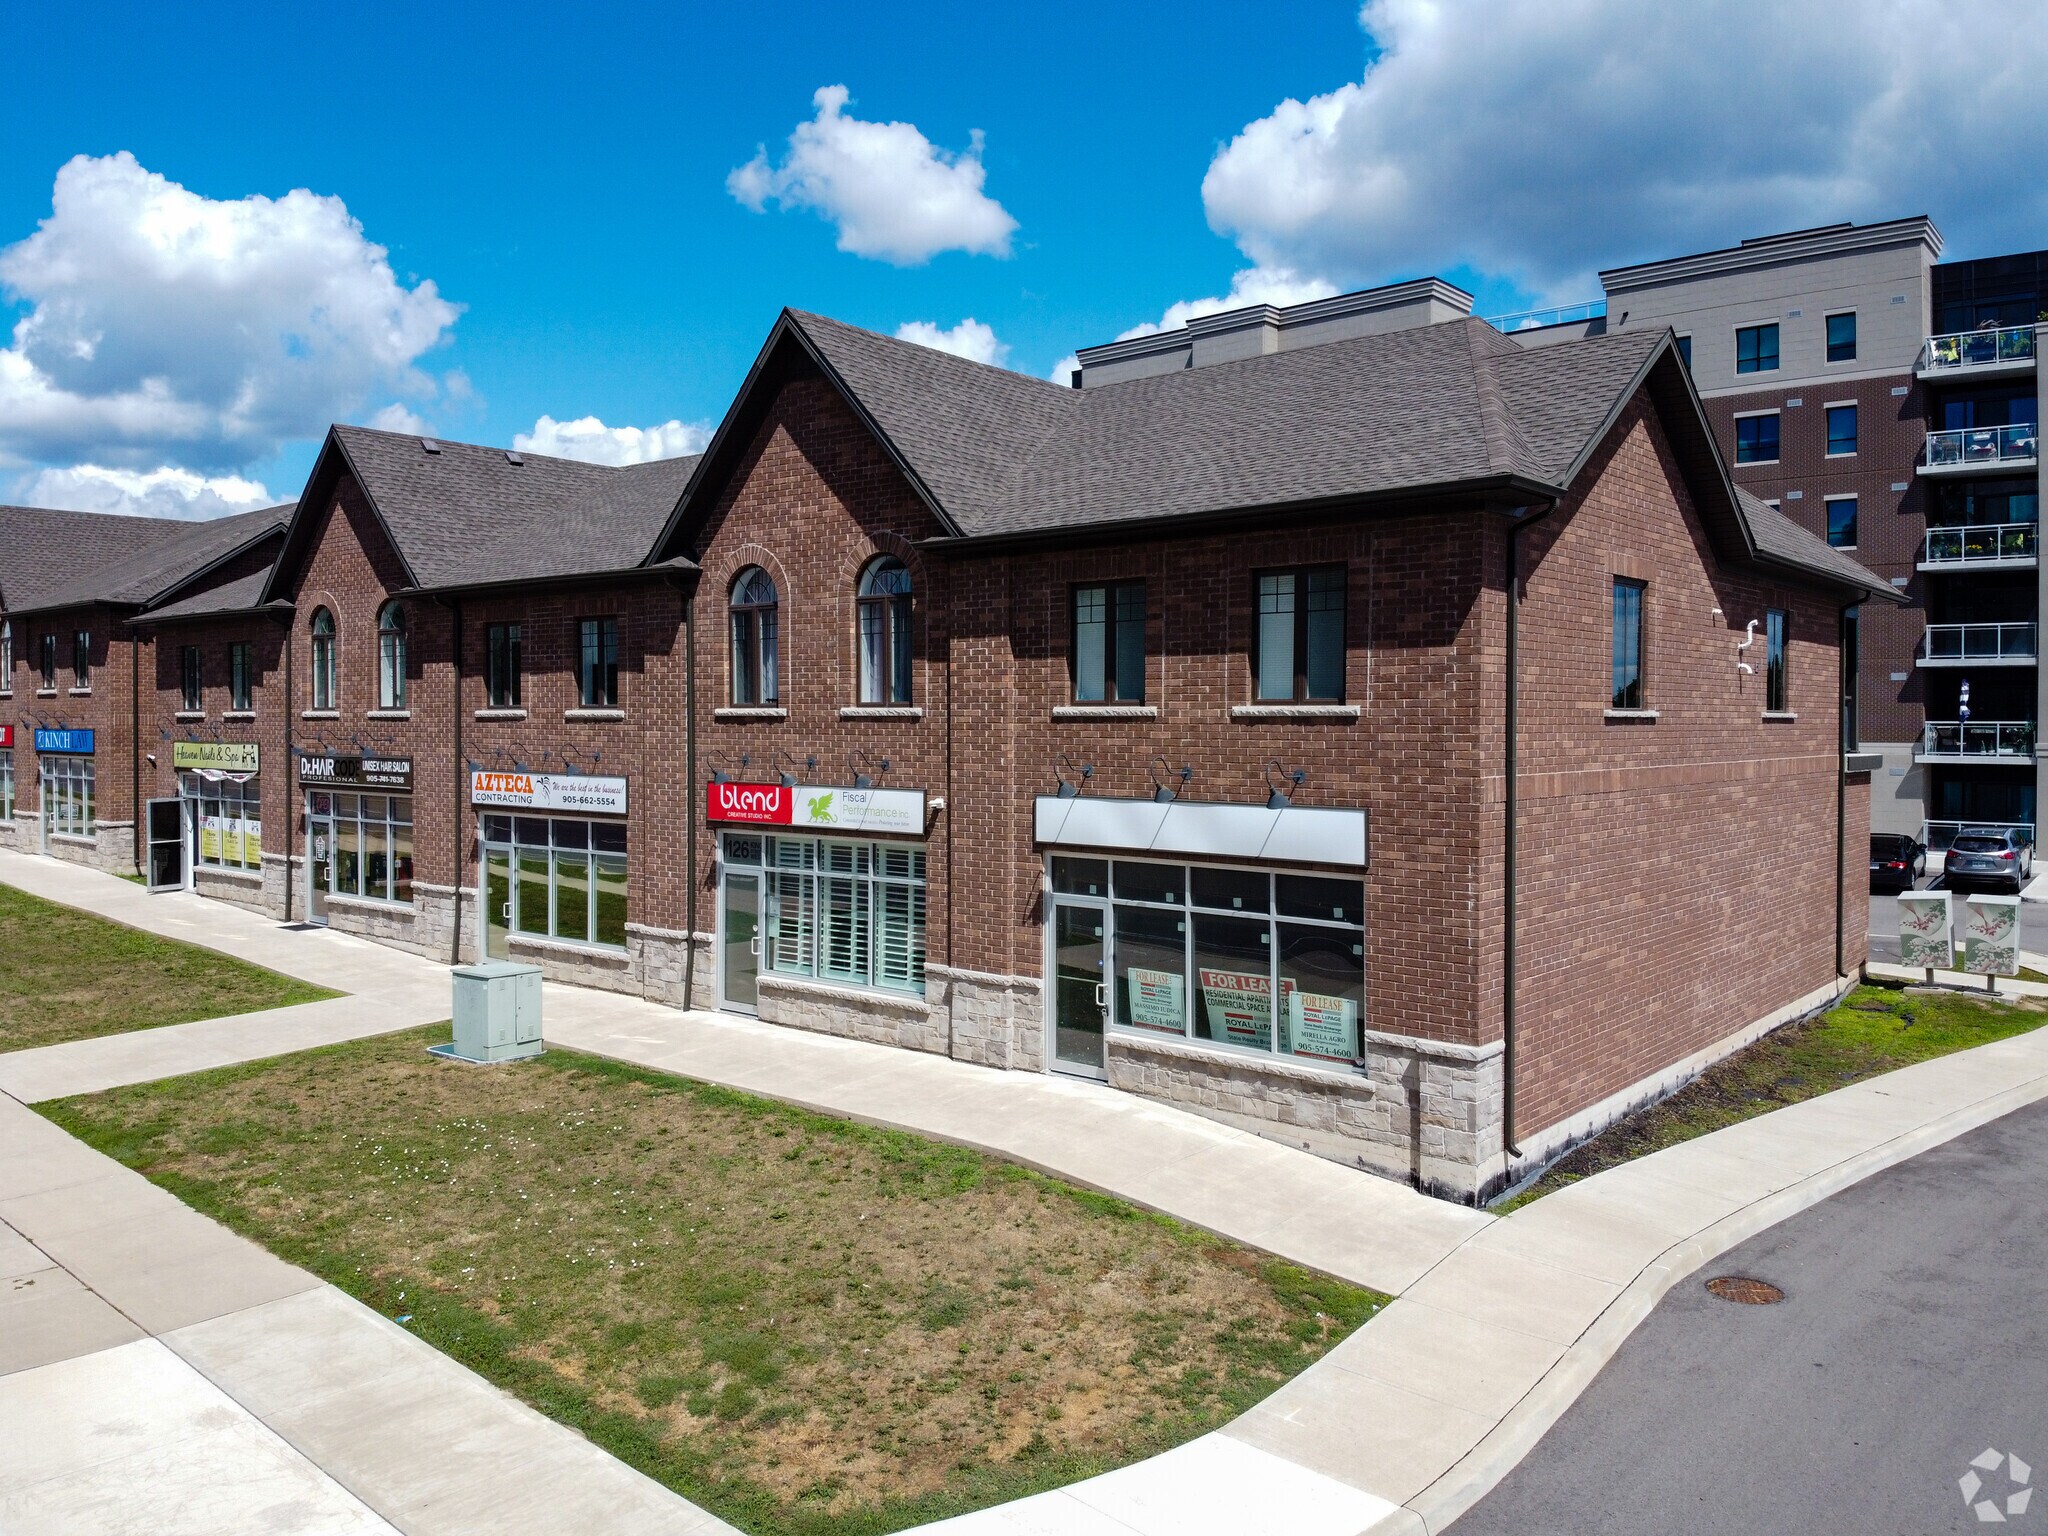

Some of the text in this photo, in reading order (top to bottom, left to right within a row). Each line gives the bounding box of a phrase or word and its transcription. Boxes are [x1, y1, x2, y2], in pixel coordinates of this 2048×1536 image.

[45, 732, 89, 749] KINCH LAW
[176, 746, 240, 767] Heaven Nails & Spa
[362, 760, 410, 773] UNISEX HAIR SALON
[302, 775, 358, 783] PROFESIONAL
[366, 775, 404, 784] 905-741-7638
[475, 773, 534, 794] AZTECA
[569, 783, 577, 791] the
[577, 783, 587, 793] best
[587, 785, 593, 793] in
[593, 783, 601, 793] the
[602, 784, 624, 795] business!
[475, 792, 533, 805] CONTRACTING
[562, 795, 616, 806] 905-662-5554
[721, 784, 780, 812] blend
[842, 791, 867, 803] Fiscal
[727, 811, 747, 819] CREATIVE
[842, 804, 898, 818] Performance
[728, 839, 750, 859] 126
[1135, 970, 1169, 985] FOR LEASE
[1208, 973, 1287, 996] FOR LEAE
[1206, 989, 1245, 1001] RESIDENTIAL
[1206, 998, 1246, 1010] COMMERCIAL
[1246, 1002, 1265, 1013] SPACE
[1301, 994, 1343, 1012] FOR LEASE
[1135, 1013, 1182, 1028] 905-574-4600
[1225, 1018, 1253, 1029] ROYAL
[1301, 1031, 1328, 1040] MIRELLA
[1298, 1042, 1352, 1058] 905-574-4600
